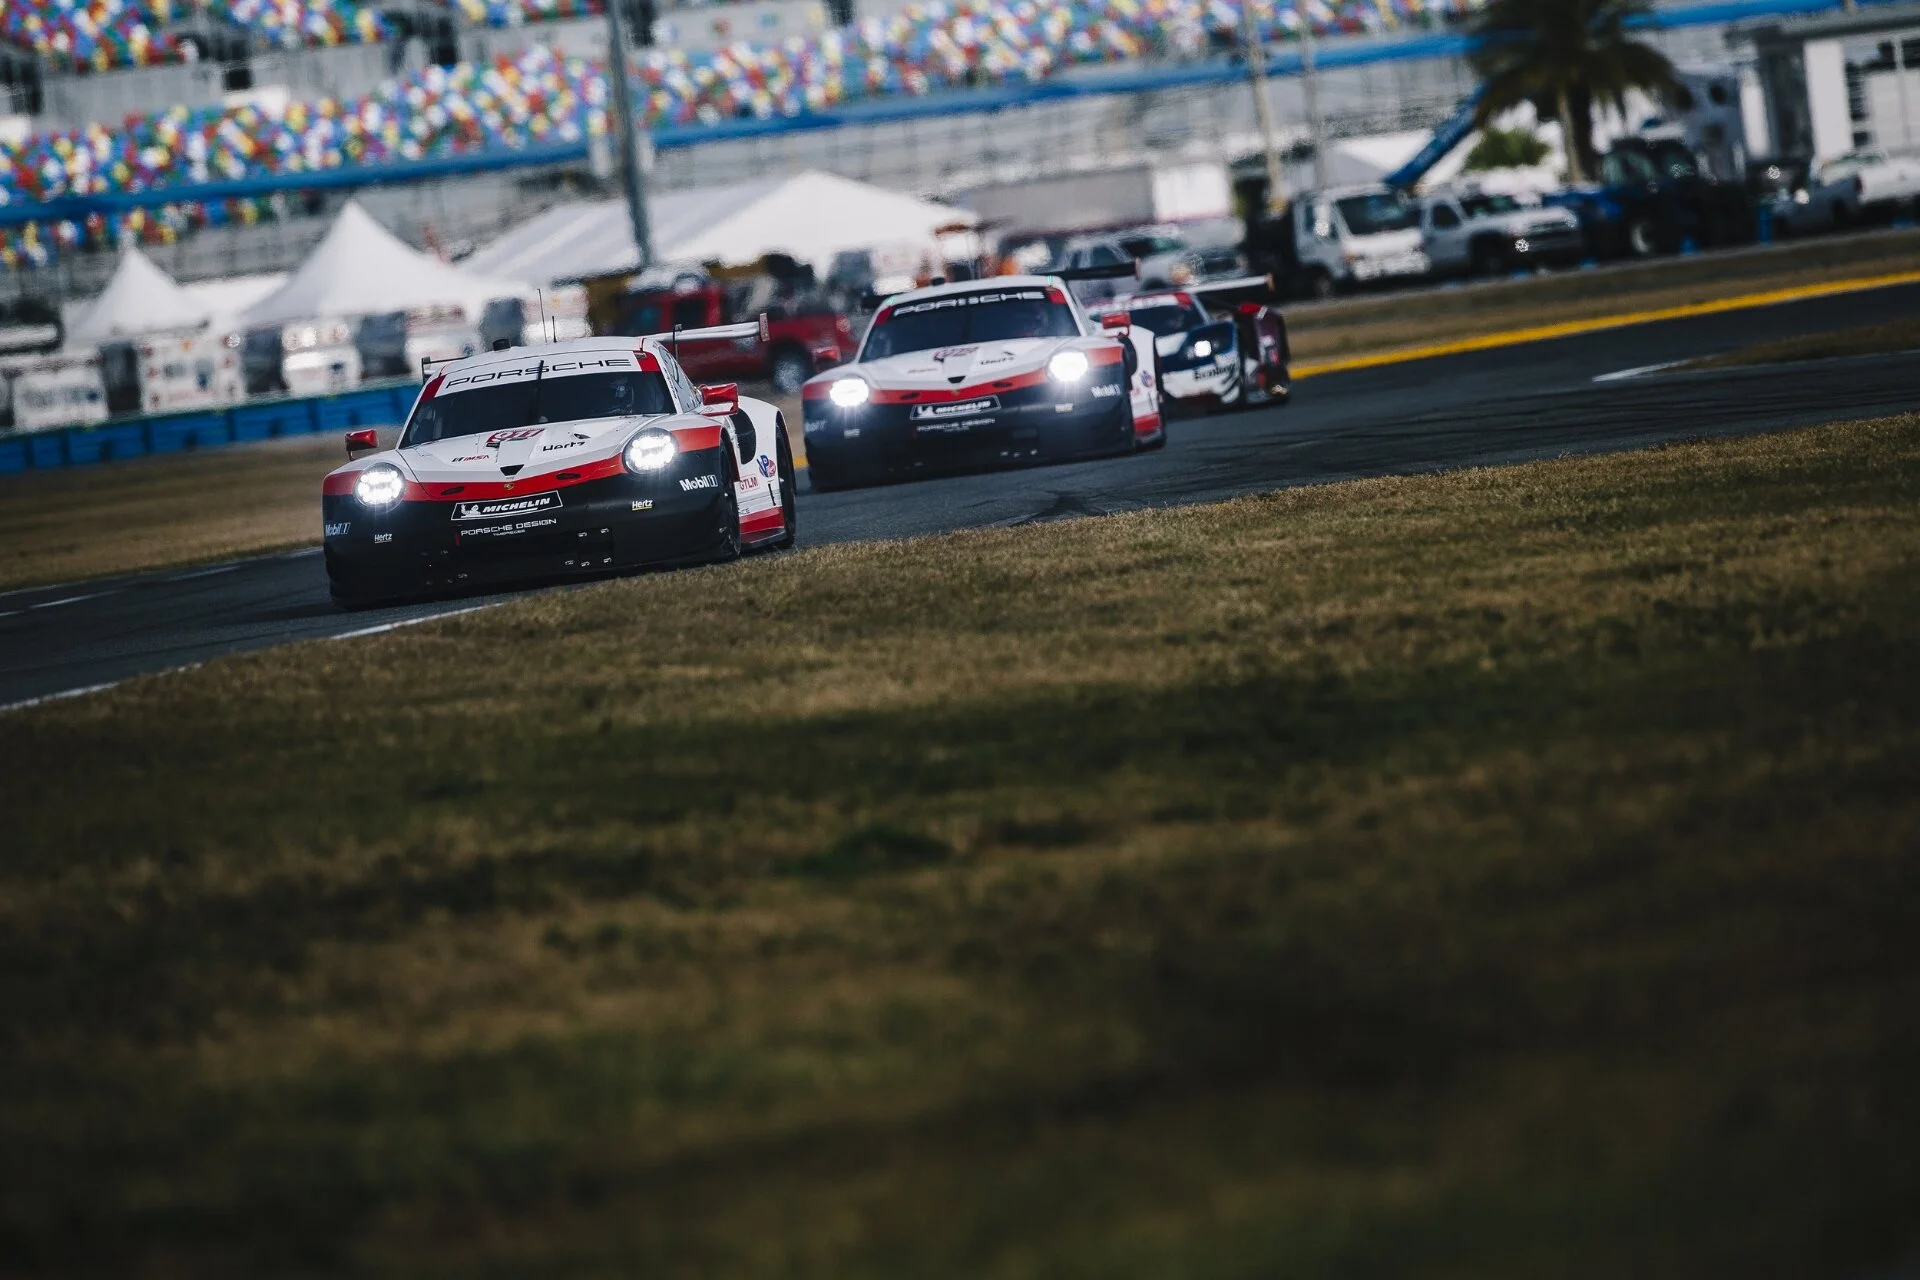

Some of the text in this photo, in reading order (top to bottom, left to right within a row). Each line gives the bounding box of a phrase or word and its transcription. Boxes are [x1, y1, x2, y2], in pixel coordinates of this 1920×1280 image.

[446, 359, 632, 389] PORSCHE
[542, 441, 586, 452] Hertz
[679, 475, 709, 492] Mobil
[740, 476, 758, 490] GTLM
[482, 498, 551, 513] MICHELIN
[632, 499, 653, 510] Hertz
[460, 518, 557, 537] PORSCHE DESIGN
[374, 533, 393, 543] Hertz
